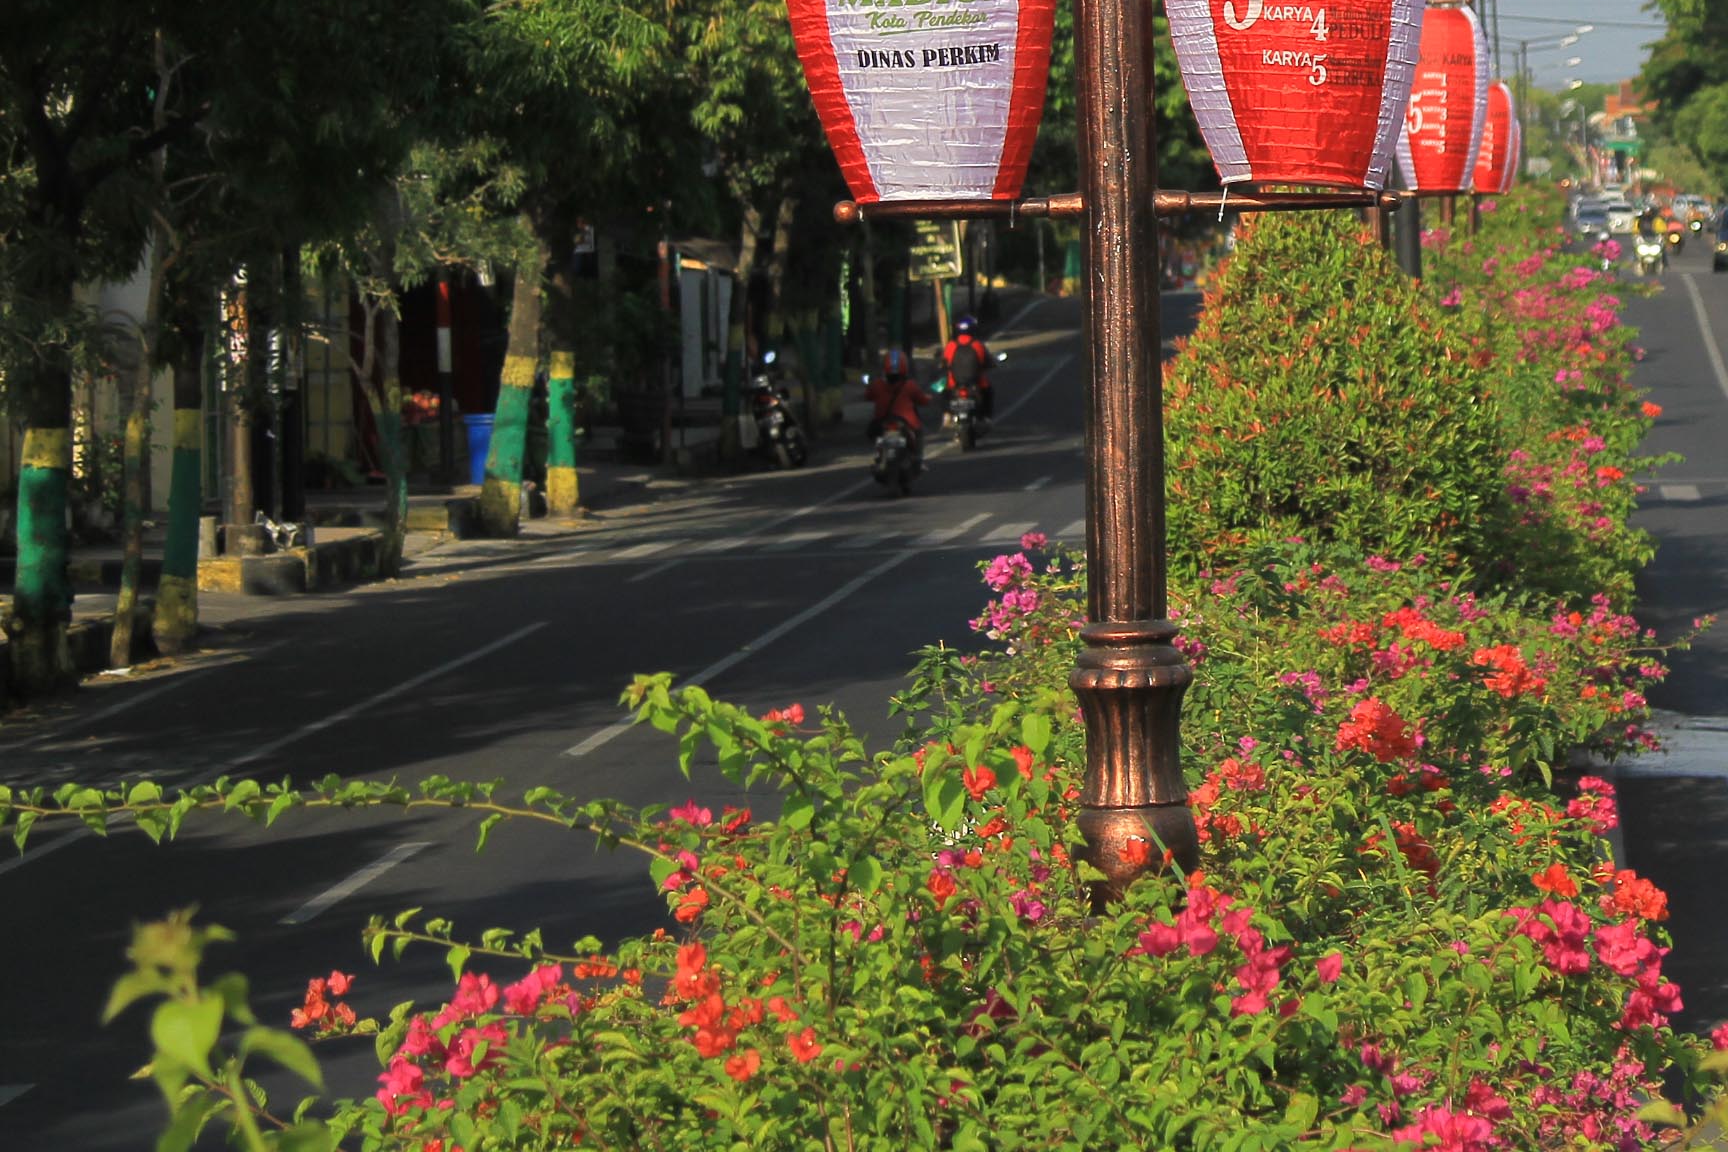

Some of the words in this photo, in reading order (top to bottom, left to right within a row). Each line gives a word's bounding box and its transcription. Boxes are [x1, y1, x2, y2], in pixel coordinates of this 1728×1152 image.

[865, 11, 907, 30] Kota
[913, 9, 989, 28] Pendekar
[1263, 6, 1313, 22] KARYA
[1310, 8, 1329, 41] 4
[1330, 23, 1384, 40] PEDULI
[857, 49, 915, 69] DINAS
[923, 43, 1000, 68] PERKIM
[1262, 49, 1312, 67] KARYA
[1308, 53, 1328, 86] 5
